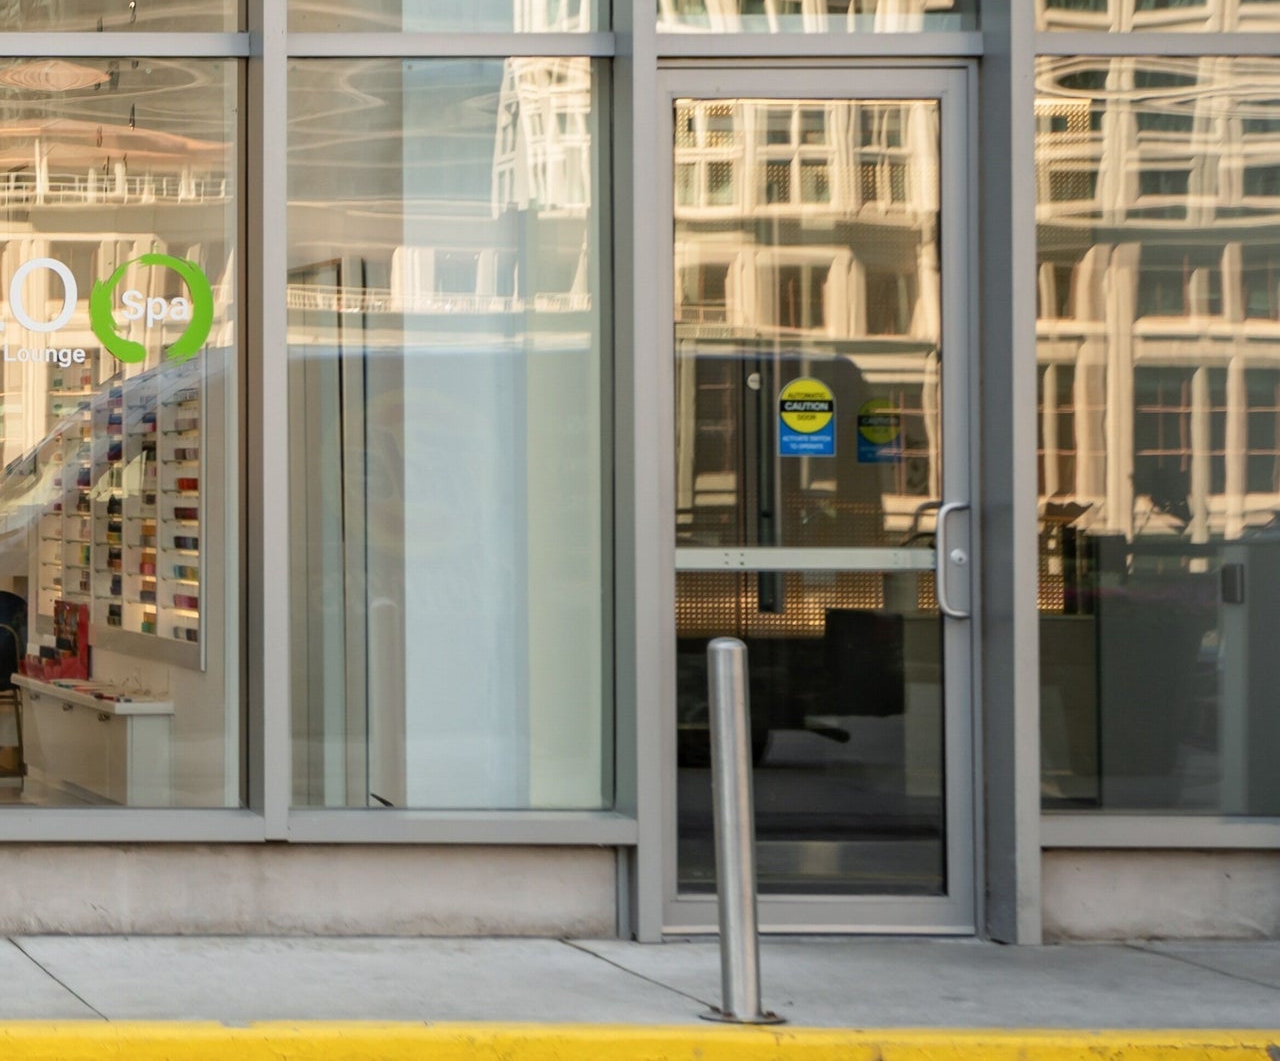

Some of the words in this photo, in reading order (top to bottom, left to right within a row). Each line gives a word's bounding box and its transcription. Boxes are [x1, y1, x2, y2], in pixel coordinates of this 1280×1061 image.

[121, 289, 190, 328] Spa
[4, 344, 87, 368] Lounge
[783, 401, 829, 411] CAUTION
